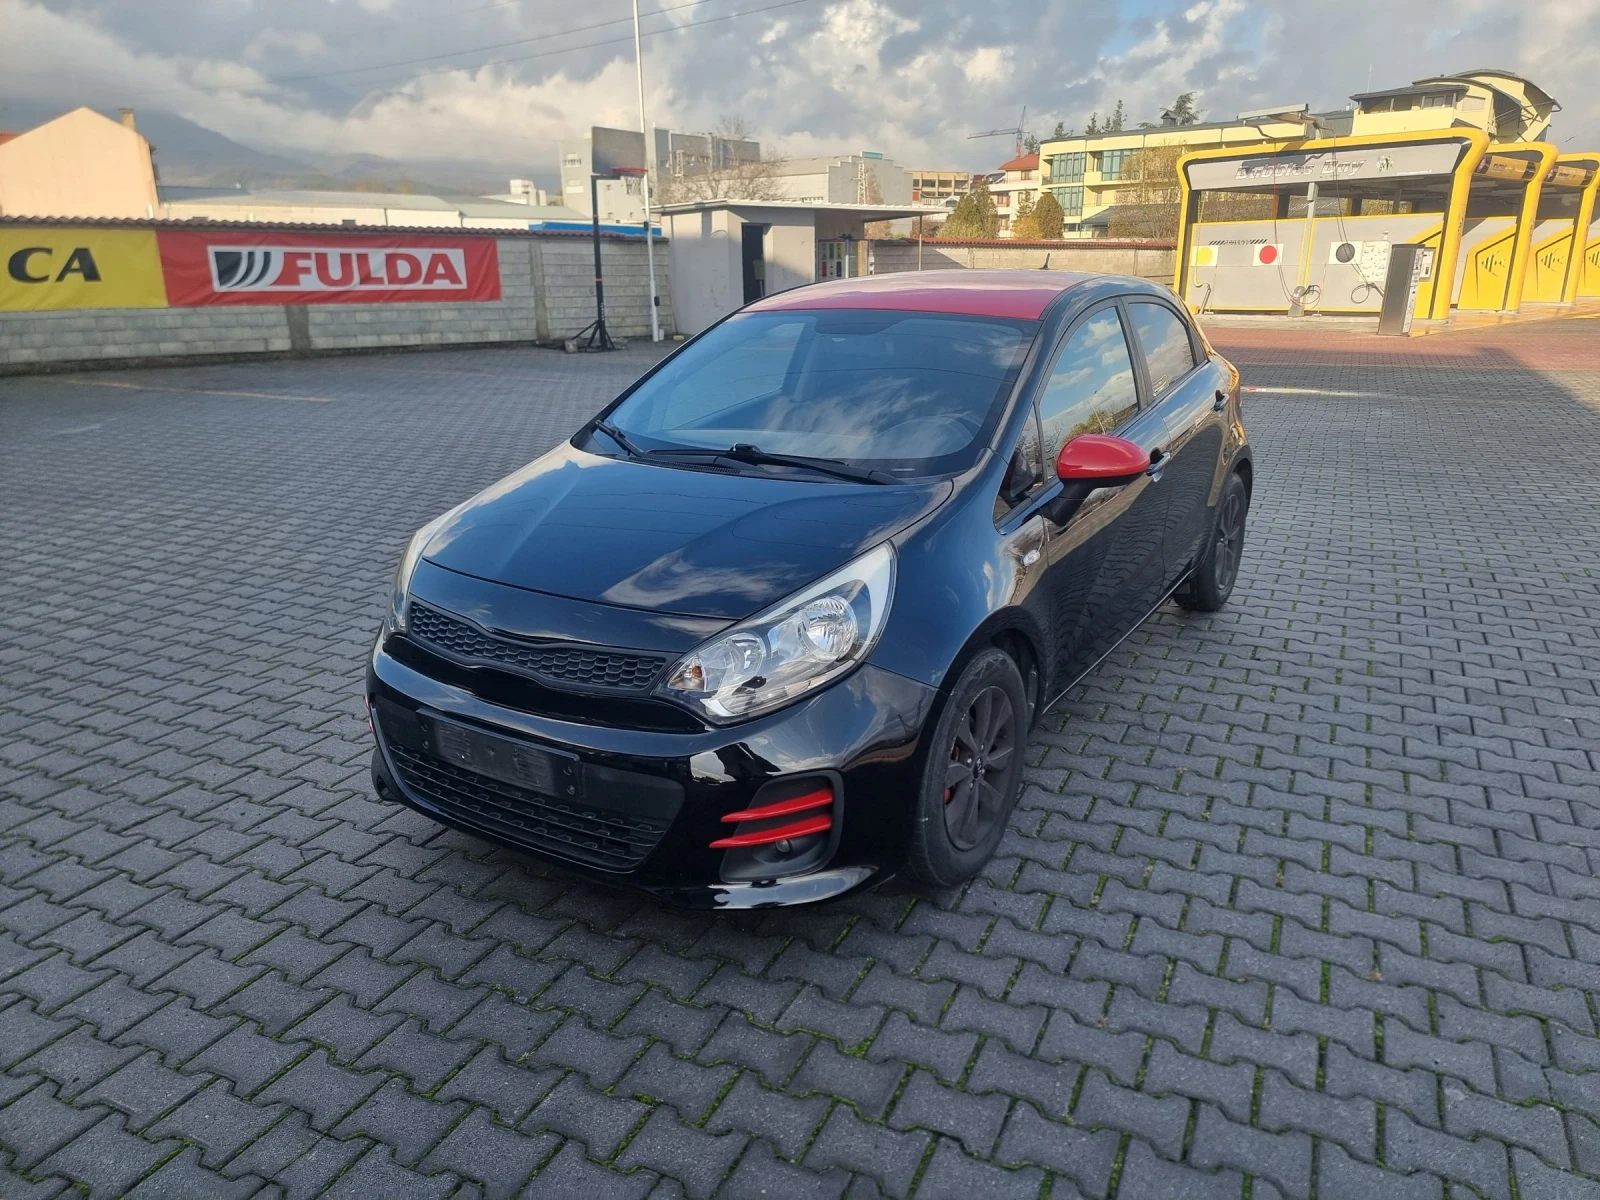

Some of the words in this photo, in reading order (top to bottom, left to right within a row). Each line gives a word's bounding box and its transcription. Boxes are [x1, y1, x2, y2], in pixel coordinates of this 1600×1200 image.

[1321, 158, 1367, 176] Bay
[8, 247, 102, 283] CA
[268, 251, 463, 287] FULDA
